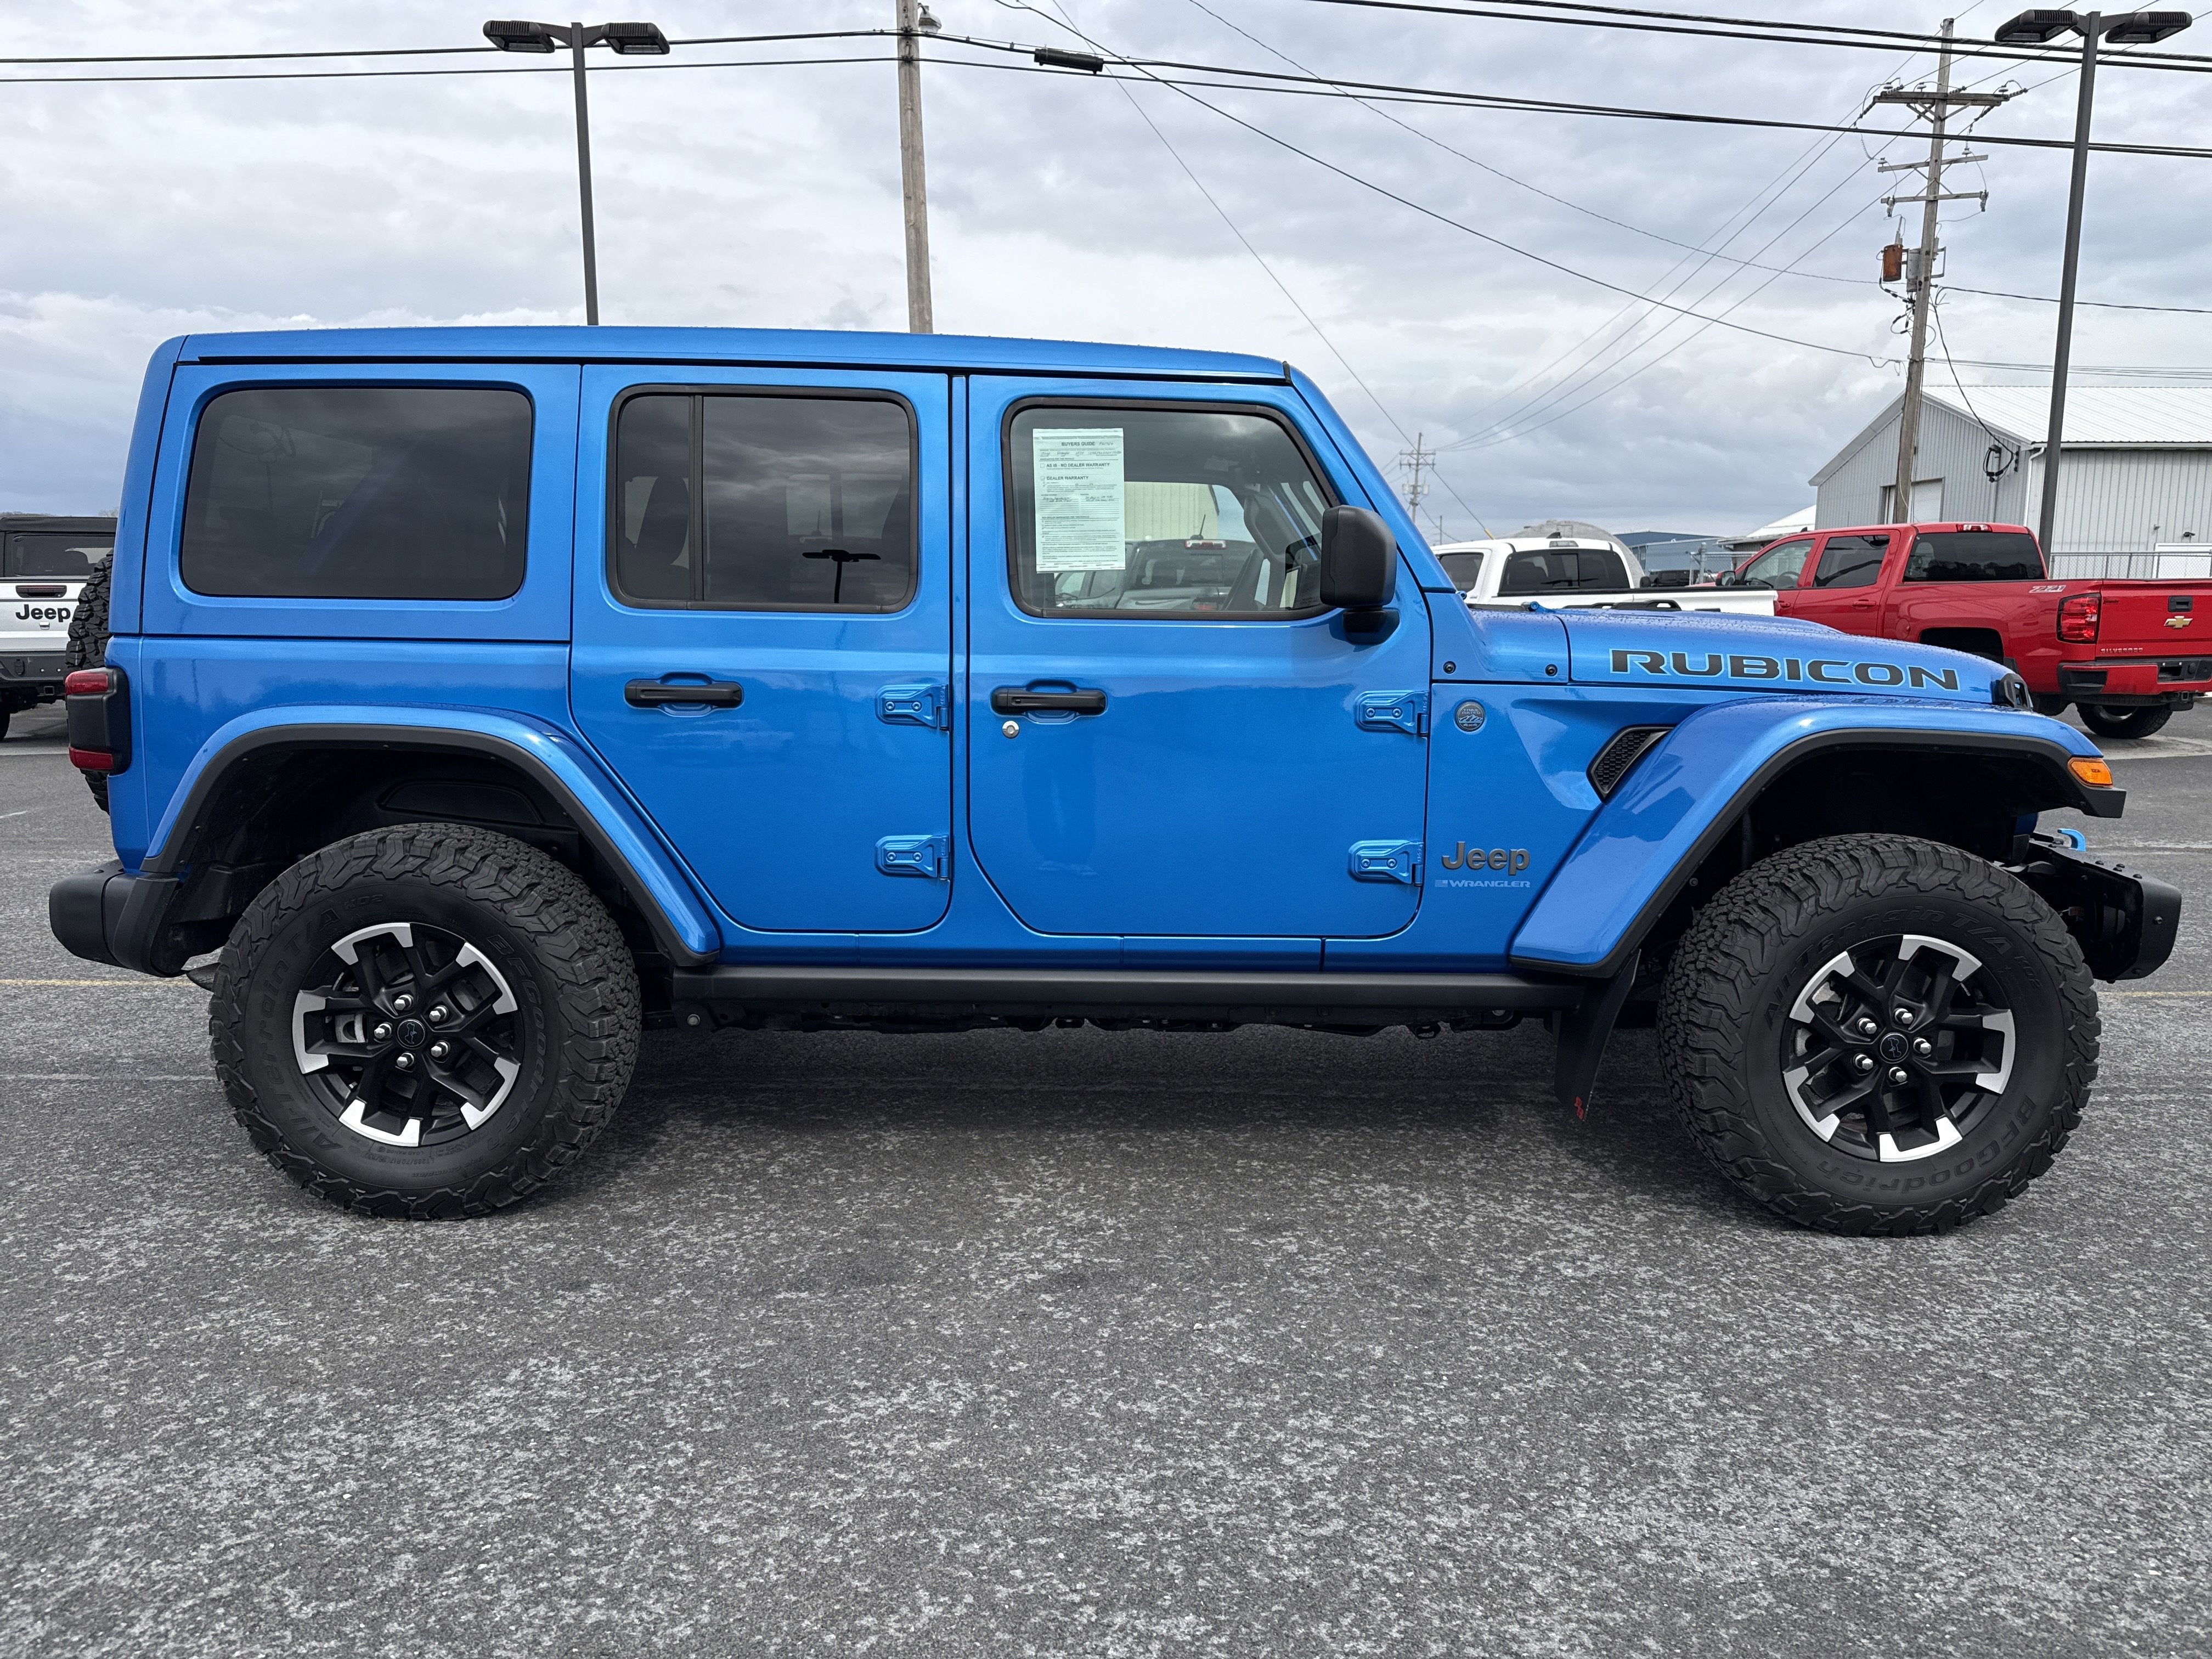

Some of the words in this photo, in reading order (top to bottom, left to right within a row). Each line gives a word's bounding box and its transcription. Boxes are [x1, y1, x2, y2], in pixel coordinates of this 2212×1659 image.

[15, 604, 71, 623] Jeep
[1609, 648, 1960, 692] RUBICON
[1441, 841, 1530, 876] Jeep
[1816, 1094, 2037, 1194] BFGoodrich
